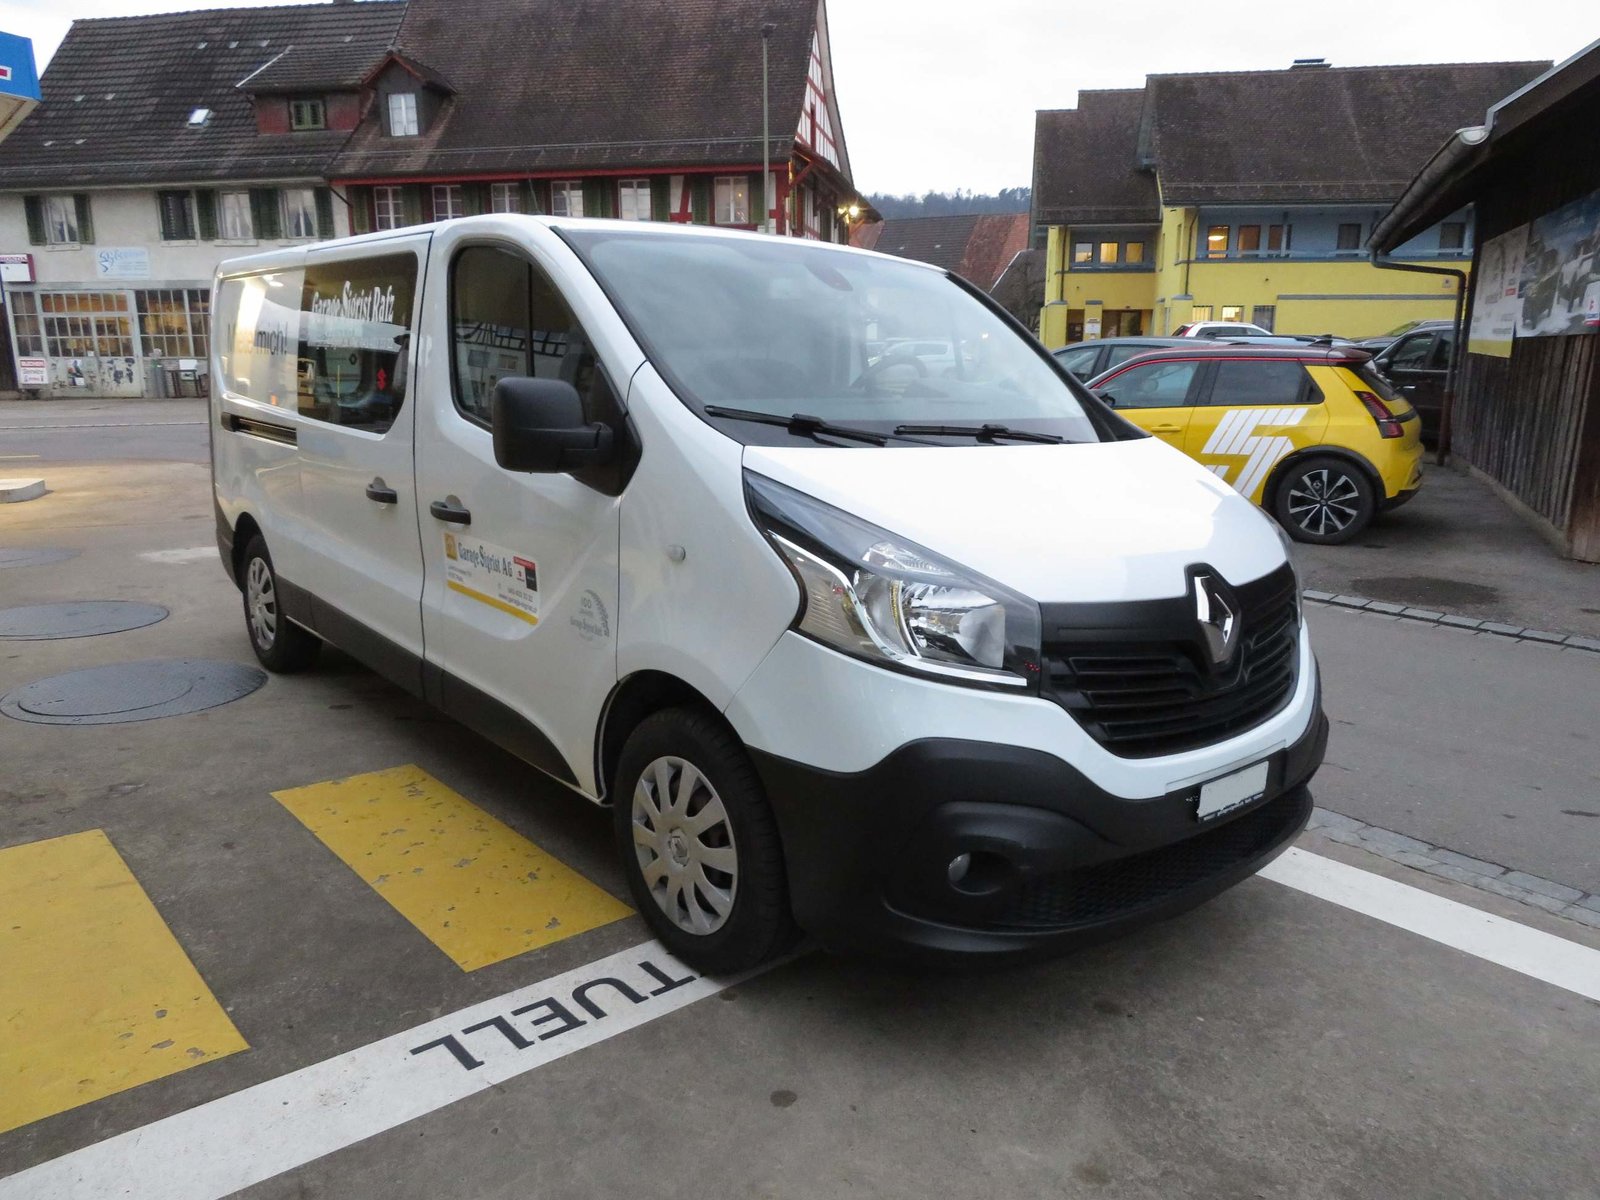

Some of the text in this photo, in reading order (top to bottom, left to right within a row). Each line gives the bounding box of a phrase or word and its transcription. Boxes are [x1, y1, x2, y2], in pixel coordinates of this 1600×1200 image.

[312, 281, 395, 323] Garage Sigrist Rafz
[458, 542, 479, 568] Garage
[479, 545, 501, 574] Sigrist
[502, 557, 513, 577] AG
[409, 959, 699, 1071] TUELL
